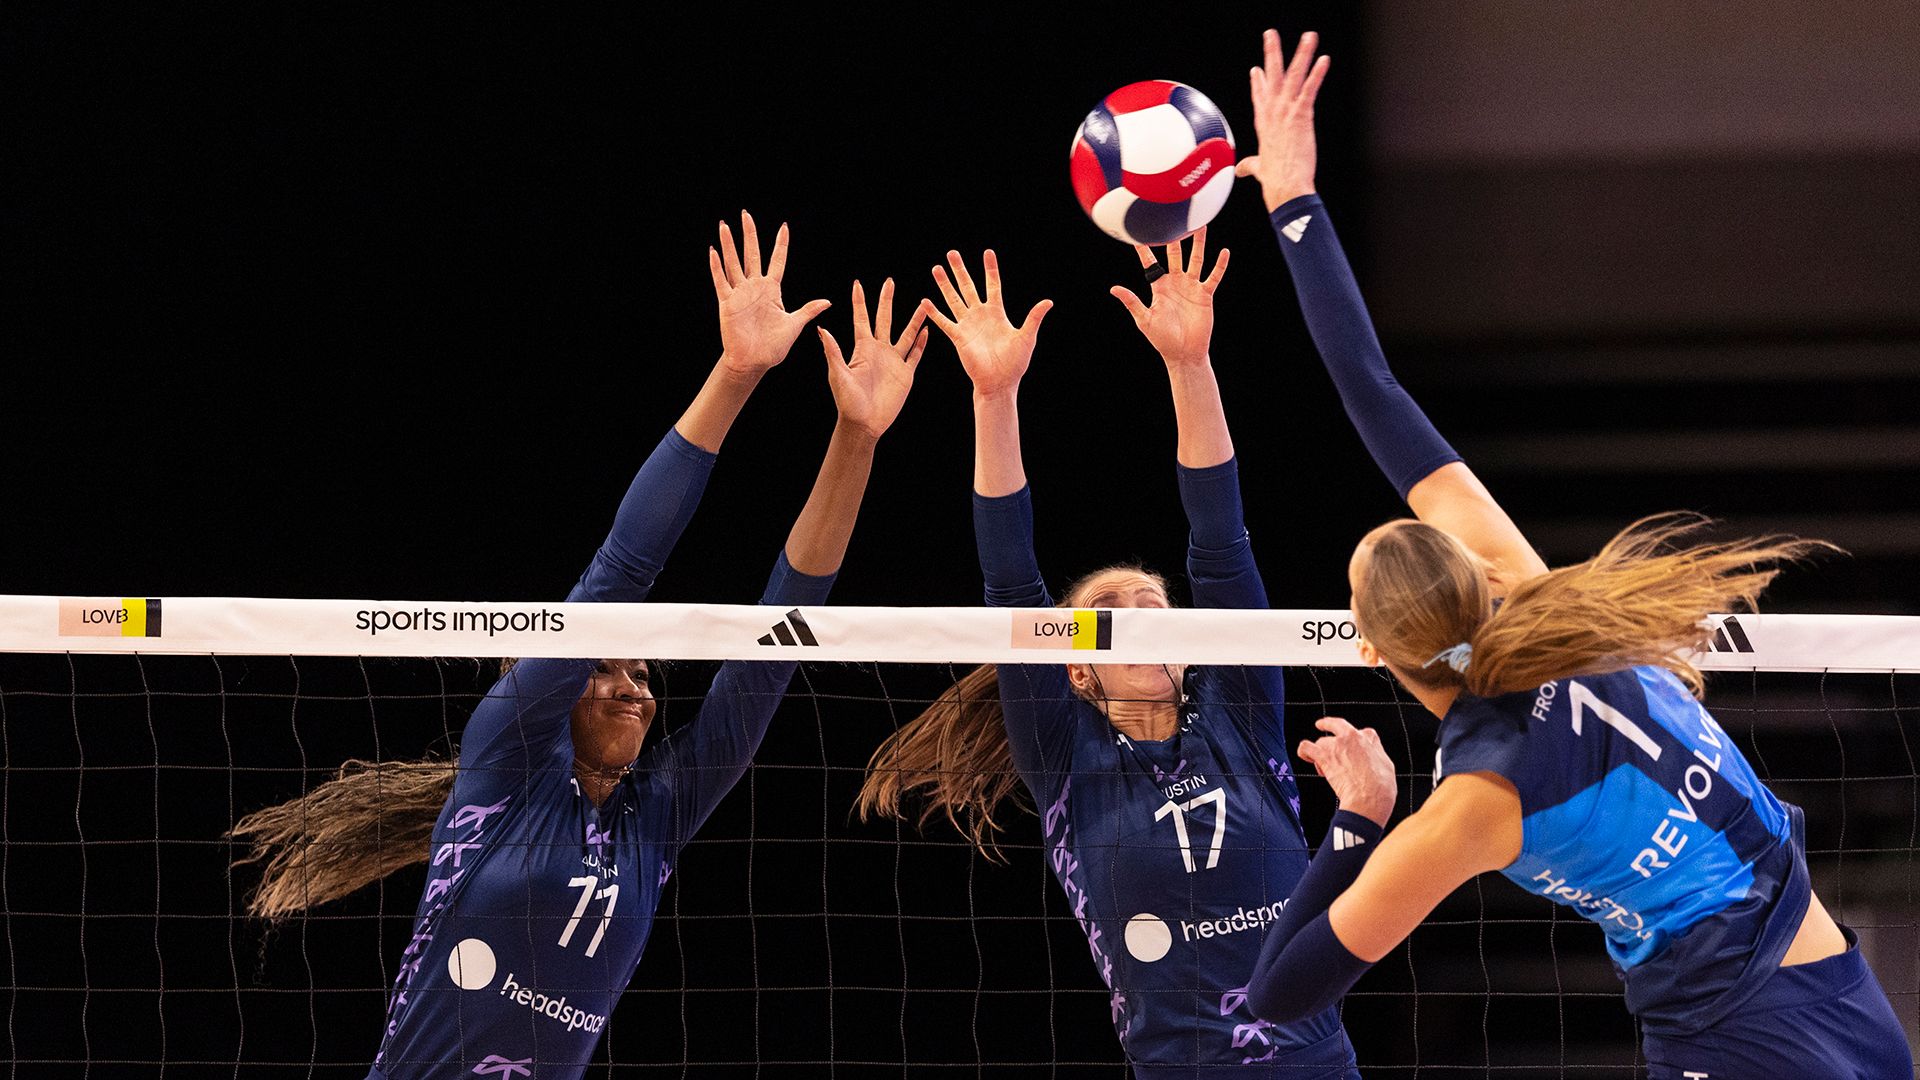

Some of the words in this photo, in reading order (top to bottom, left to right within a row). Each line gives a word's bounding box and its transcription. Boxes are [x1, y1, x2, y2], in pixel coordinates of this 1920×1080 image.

[355, 608, 447, 635] sports
[452, 609, 565, 637] imports
[1301, 621, 1362, 645] spo
[1531, 680, 1559, 722] FRO
[1162, 774, 1208, 800] USTIN
[1154, 787, 1226, 874] 17
